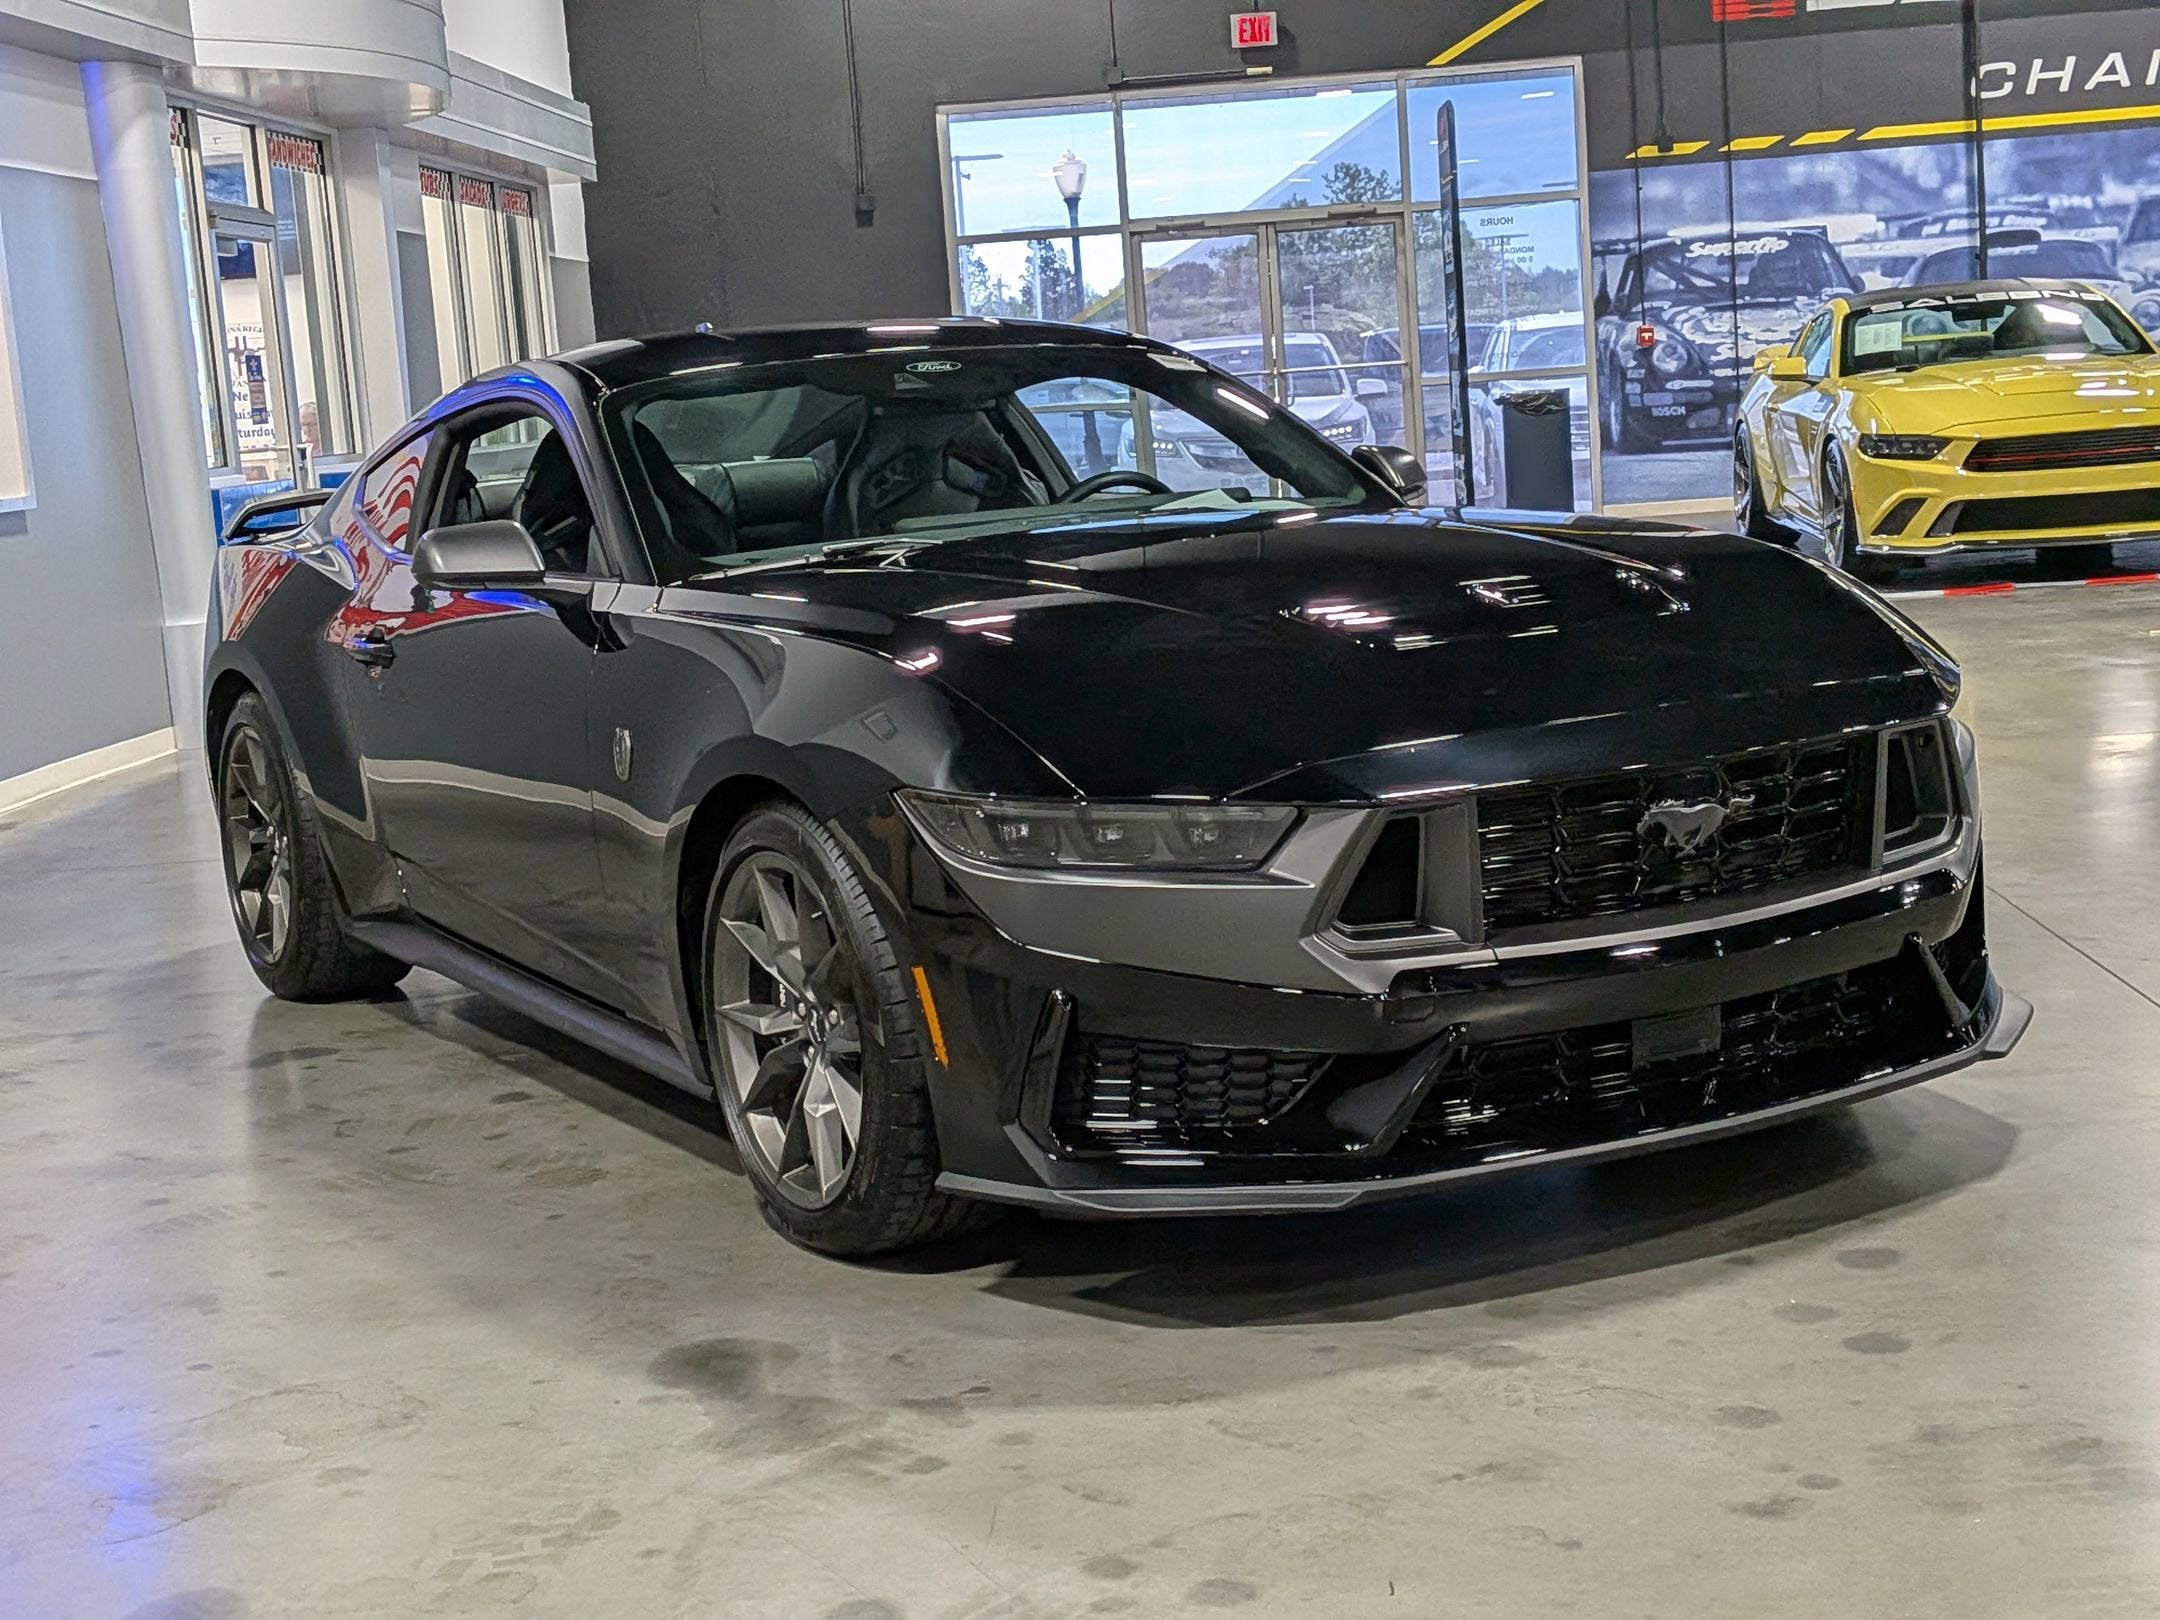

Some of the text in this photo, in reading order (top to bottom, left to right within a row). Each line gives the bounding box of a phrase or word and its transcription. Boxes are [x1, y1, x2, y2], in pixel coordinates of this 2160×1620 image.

[1238, 16, 1271, 43] EXIT
[268, 137, 315, 169] ANDWICHES
[915, 361, 954, 372] Ford
[237, 427, 275, 439] turday
